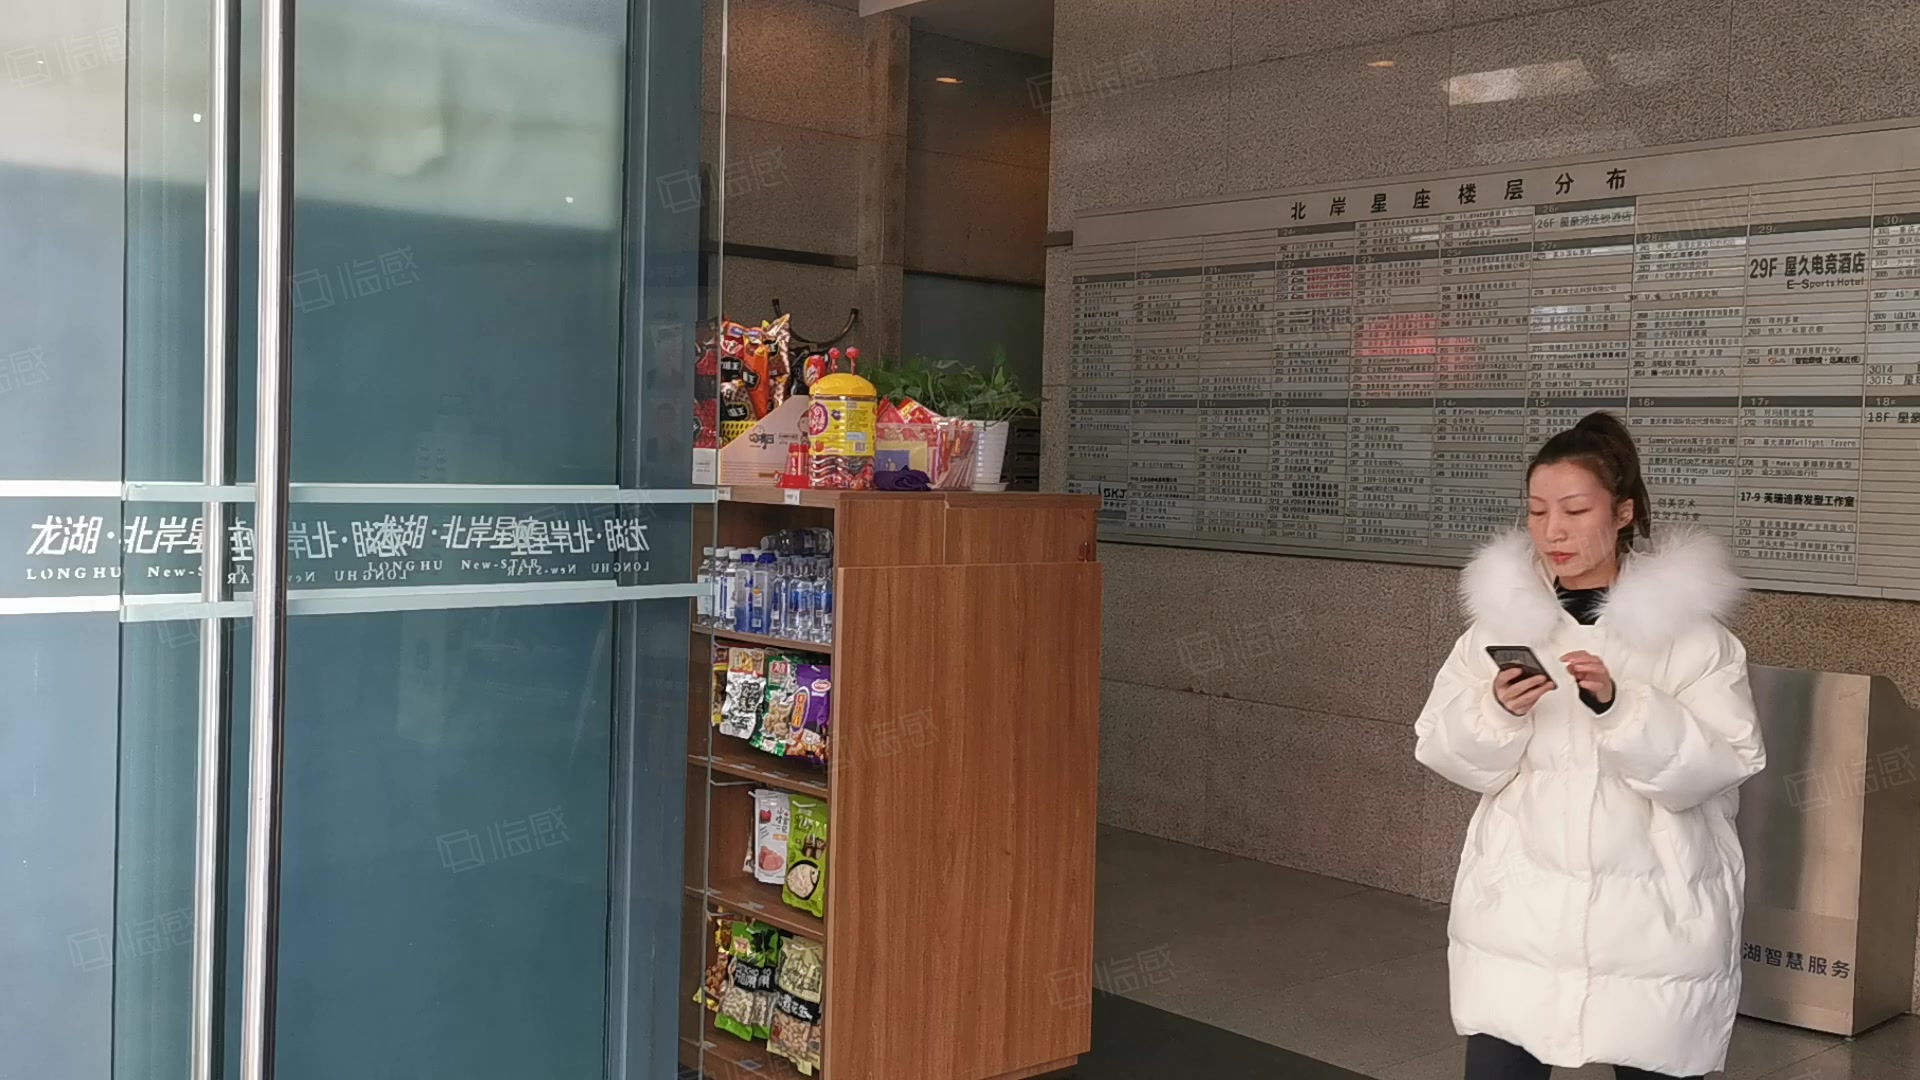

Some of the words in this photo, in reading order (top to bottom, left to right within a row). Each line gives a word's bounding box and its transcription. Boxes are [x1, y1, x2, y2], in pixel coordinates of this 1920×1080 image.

[1290, 167, 1627, 221] 北岸星座楼层分布
[1537, 218, 1555, 229] 26F
[1750, 257, 1778, 279] 29F
[1784, 251, 1866, 277] 屋久电竞酒店
[1787, 278, 1835, 290] E-Sports
[1837, 277, 1864, 287] Hotel
[1869, 364, 1892, 374] 3014
[1869, 376, 1892, 385] 3015
[1868, 411, 1890, 423] 18F
[1740, 491, 1760, 502] 17-9
[1743, 942, 1851, 979] 湖智慧服务
